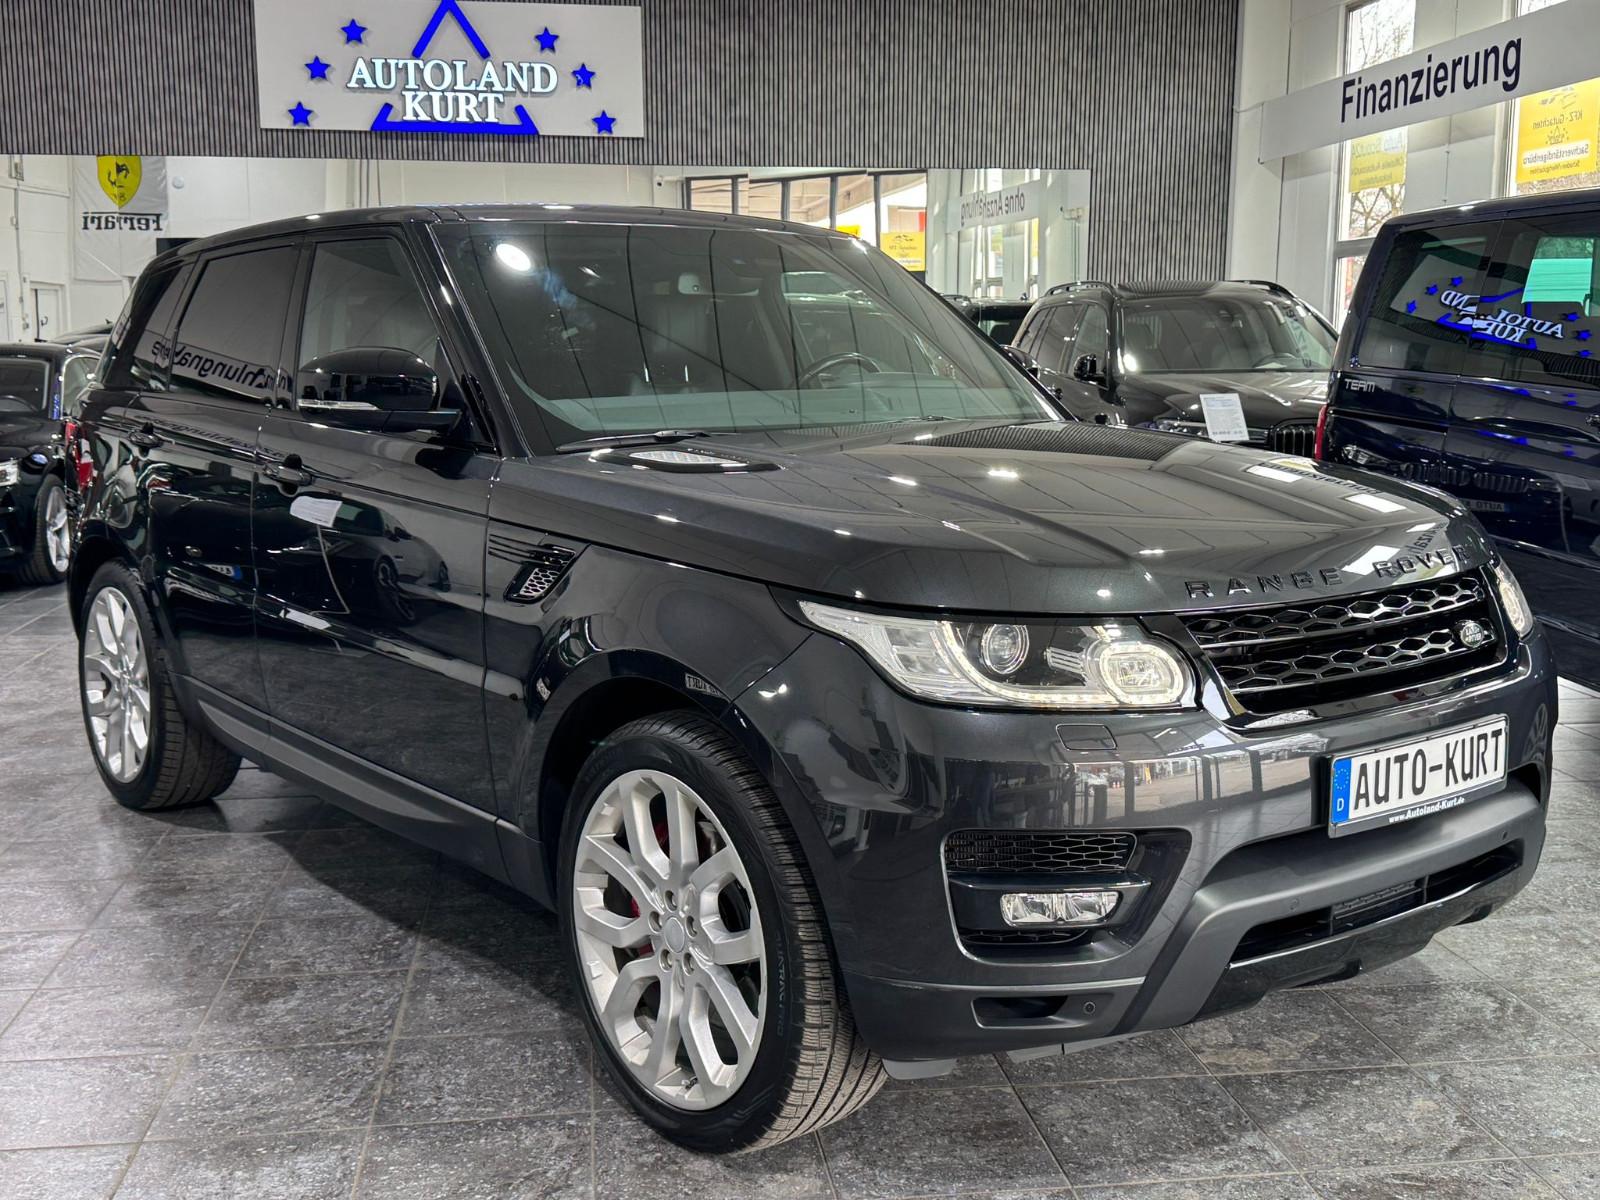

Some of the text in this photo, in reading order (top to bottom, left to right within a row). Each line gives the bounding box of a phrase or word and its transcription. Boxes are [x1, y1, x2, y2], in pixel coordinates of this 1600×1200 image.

[346, 56, 559, 93] AUTOLAND
[1341, 37, 1522, 123] Finanzierung
[402, 90, 504, 122] KURT
[1344, 378, 1376, 393] TEAM
[1184, 544, 1471, 599] RANGE ROVER
[1354, 728, 1503, 811] AUTO-KURT
[1336, 798, 1345, 812] D
[1388, 797, 1465, 824] www.Autoland-Kurt.de
